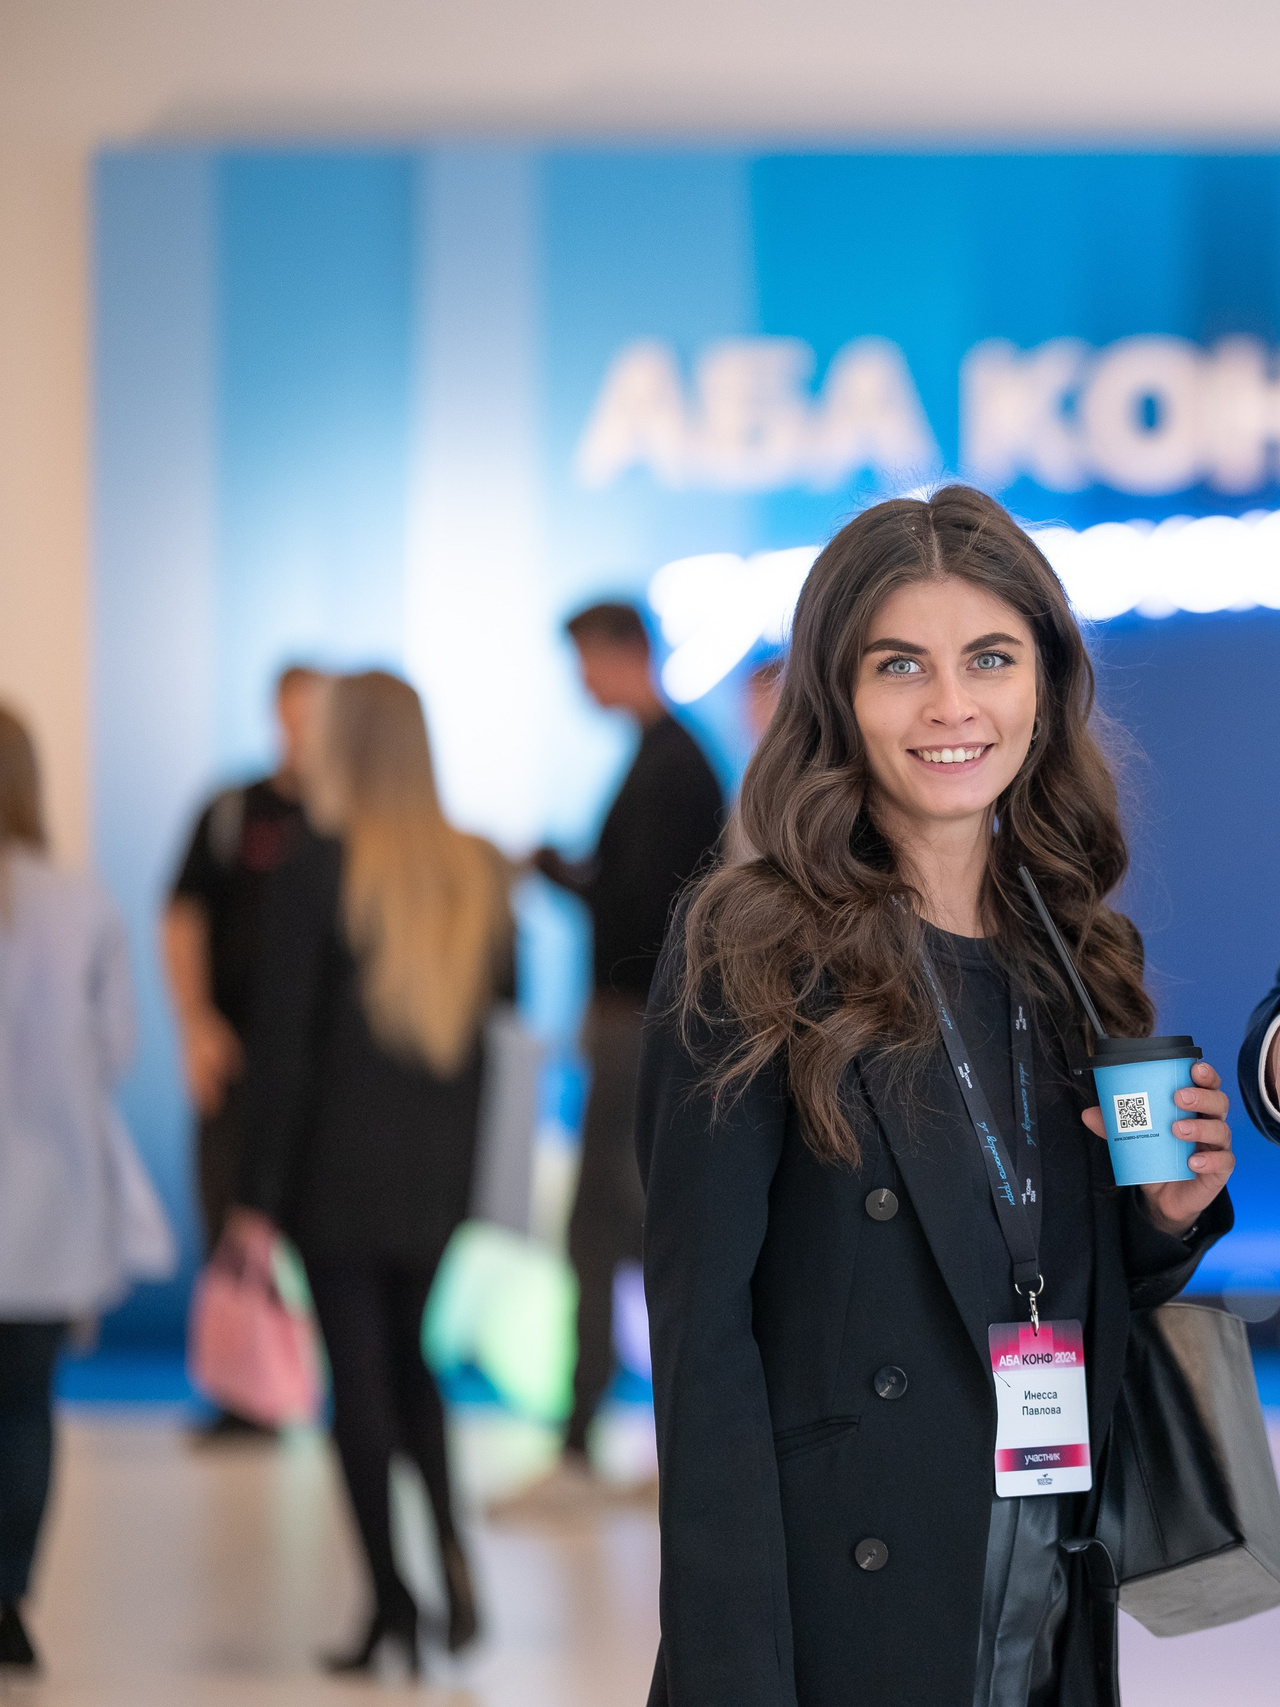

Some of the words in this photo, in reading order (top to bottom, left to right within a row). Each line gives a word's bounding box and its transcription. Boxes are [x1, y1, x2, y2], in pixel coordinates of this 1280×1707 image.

[580, 335, 938, 490] АБА
[999, 1354, 1020, 1367] АБА
[1022, 1353, 1053, 1366] КОНФ
[1054, 1351, 1077, 1364] 2024
[1024, 1390, 1058, 1400] Инесса
[1022, 1405, 1061, 1416] Павлова
[1024, 1452, 1061, 1466] участник
